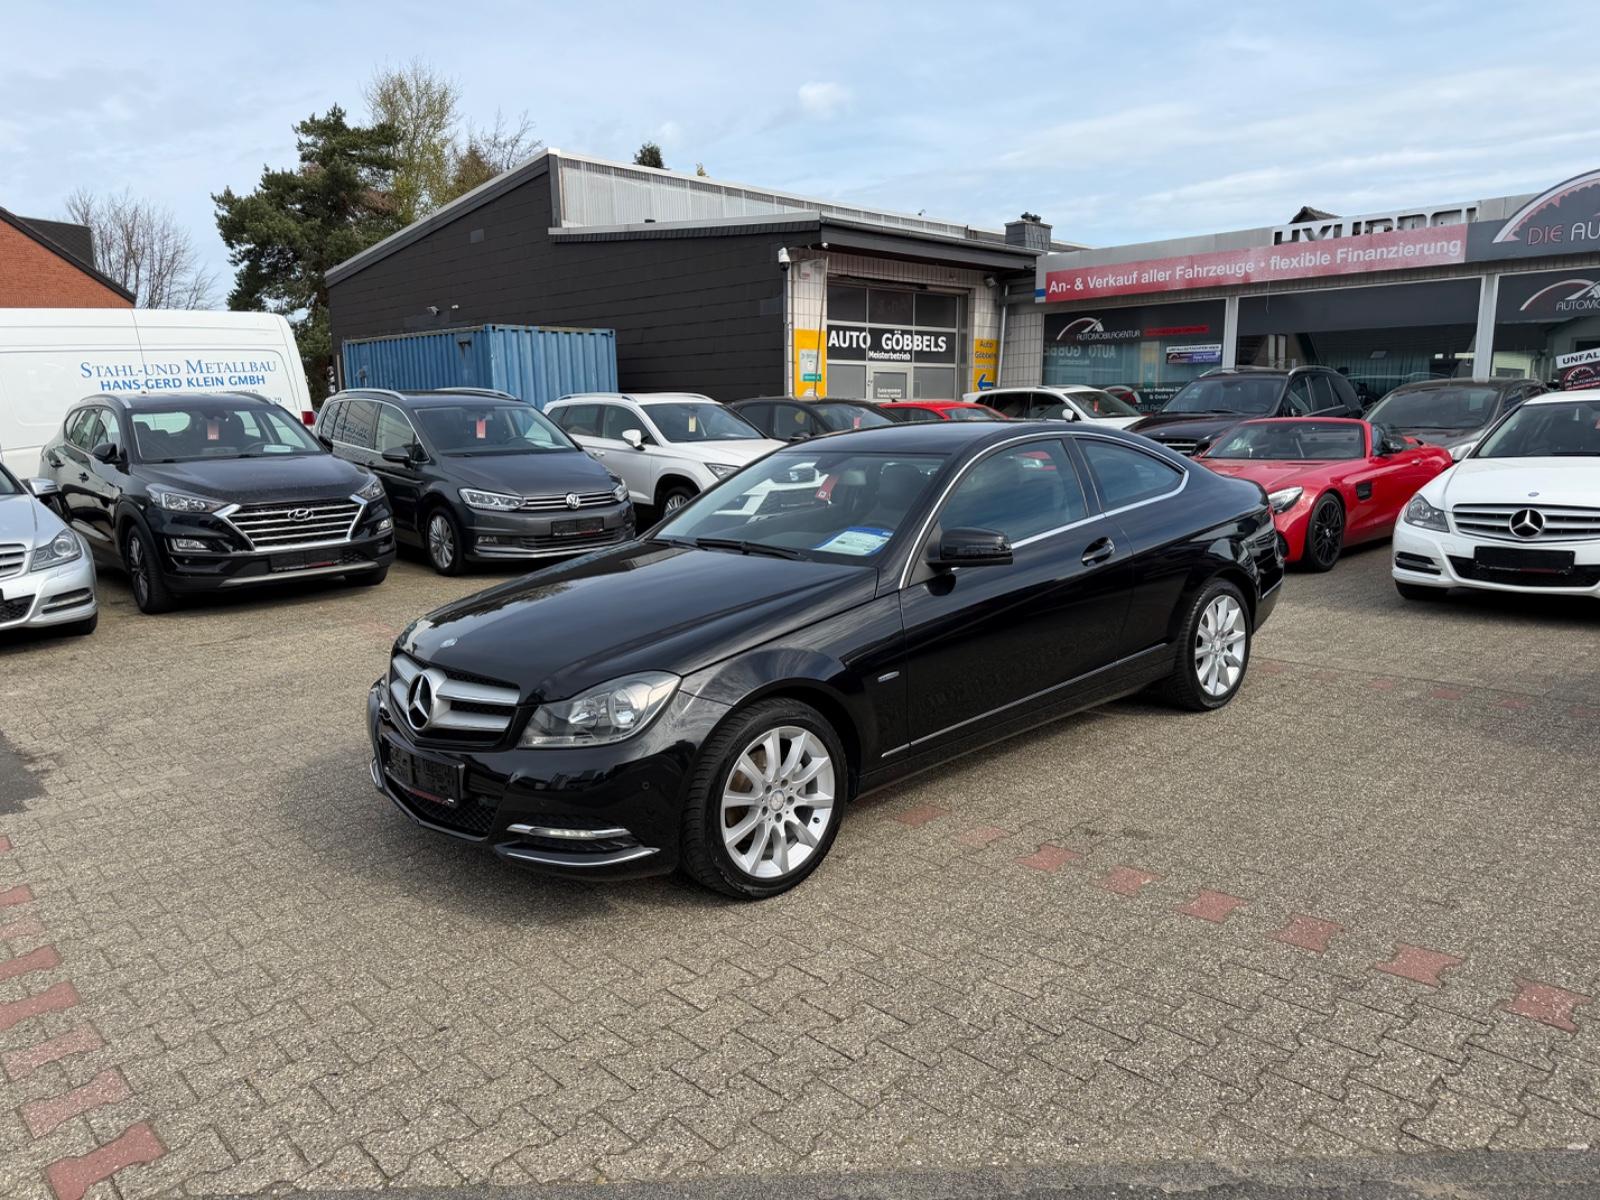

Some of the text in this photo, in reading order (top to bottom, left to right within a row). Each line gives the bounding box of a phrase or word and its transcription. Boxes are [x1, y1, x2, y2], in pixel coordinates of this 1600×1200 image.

[1527, 224, 1564, 245] DIE
[1049, 239, 1462, 293] An- & Verkauf aller Fahrzeuge flexible Finanzierung
[828, 330, 947, 352] AUTO GÖBBELS
[868, 350, 911, 360] Meisterbetrieb
[185, 359, 277, 375] METALLBAU
[100, 375, 266, 391] HANS-GERD KLEIN GMBH
